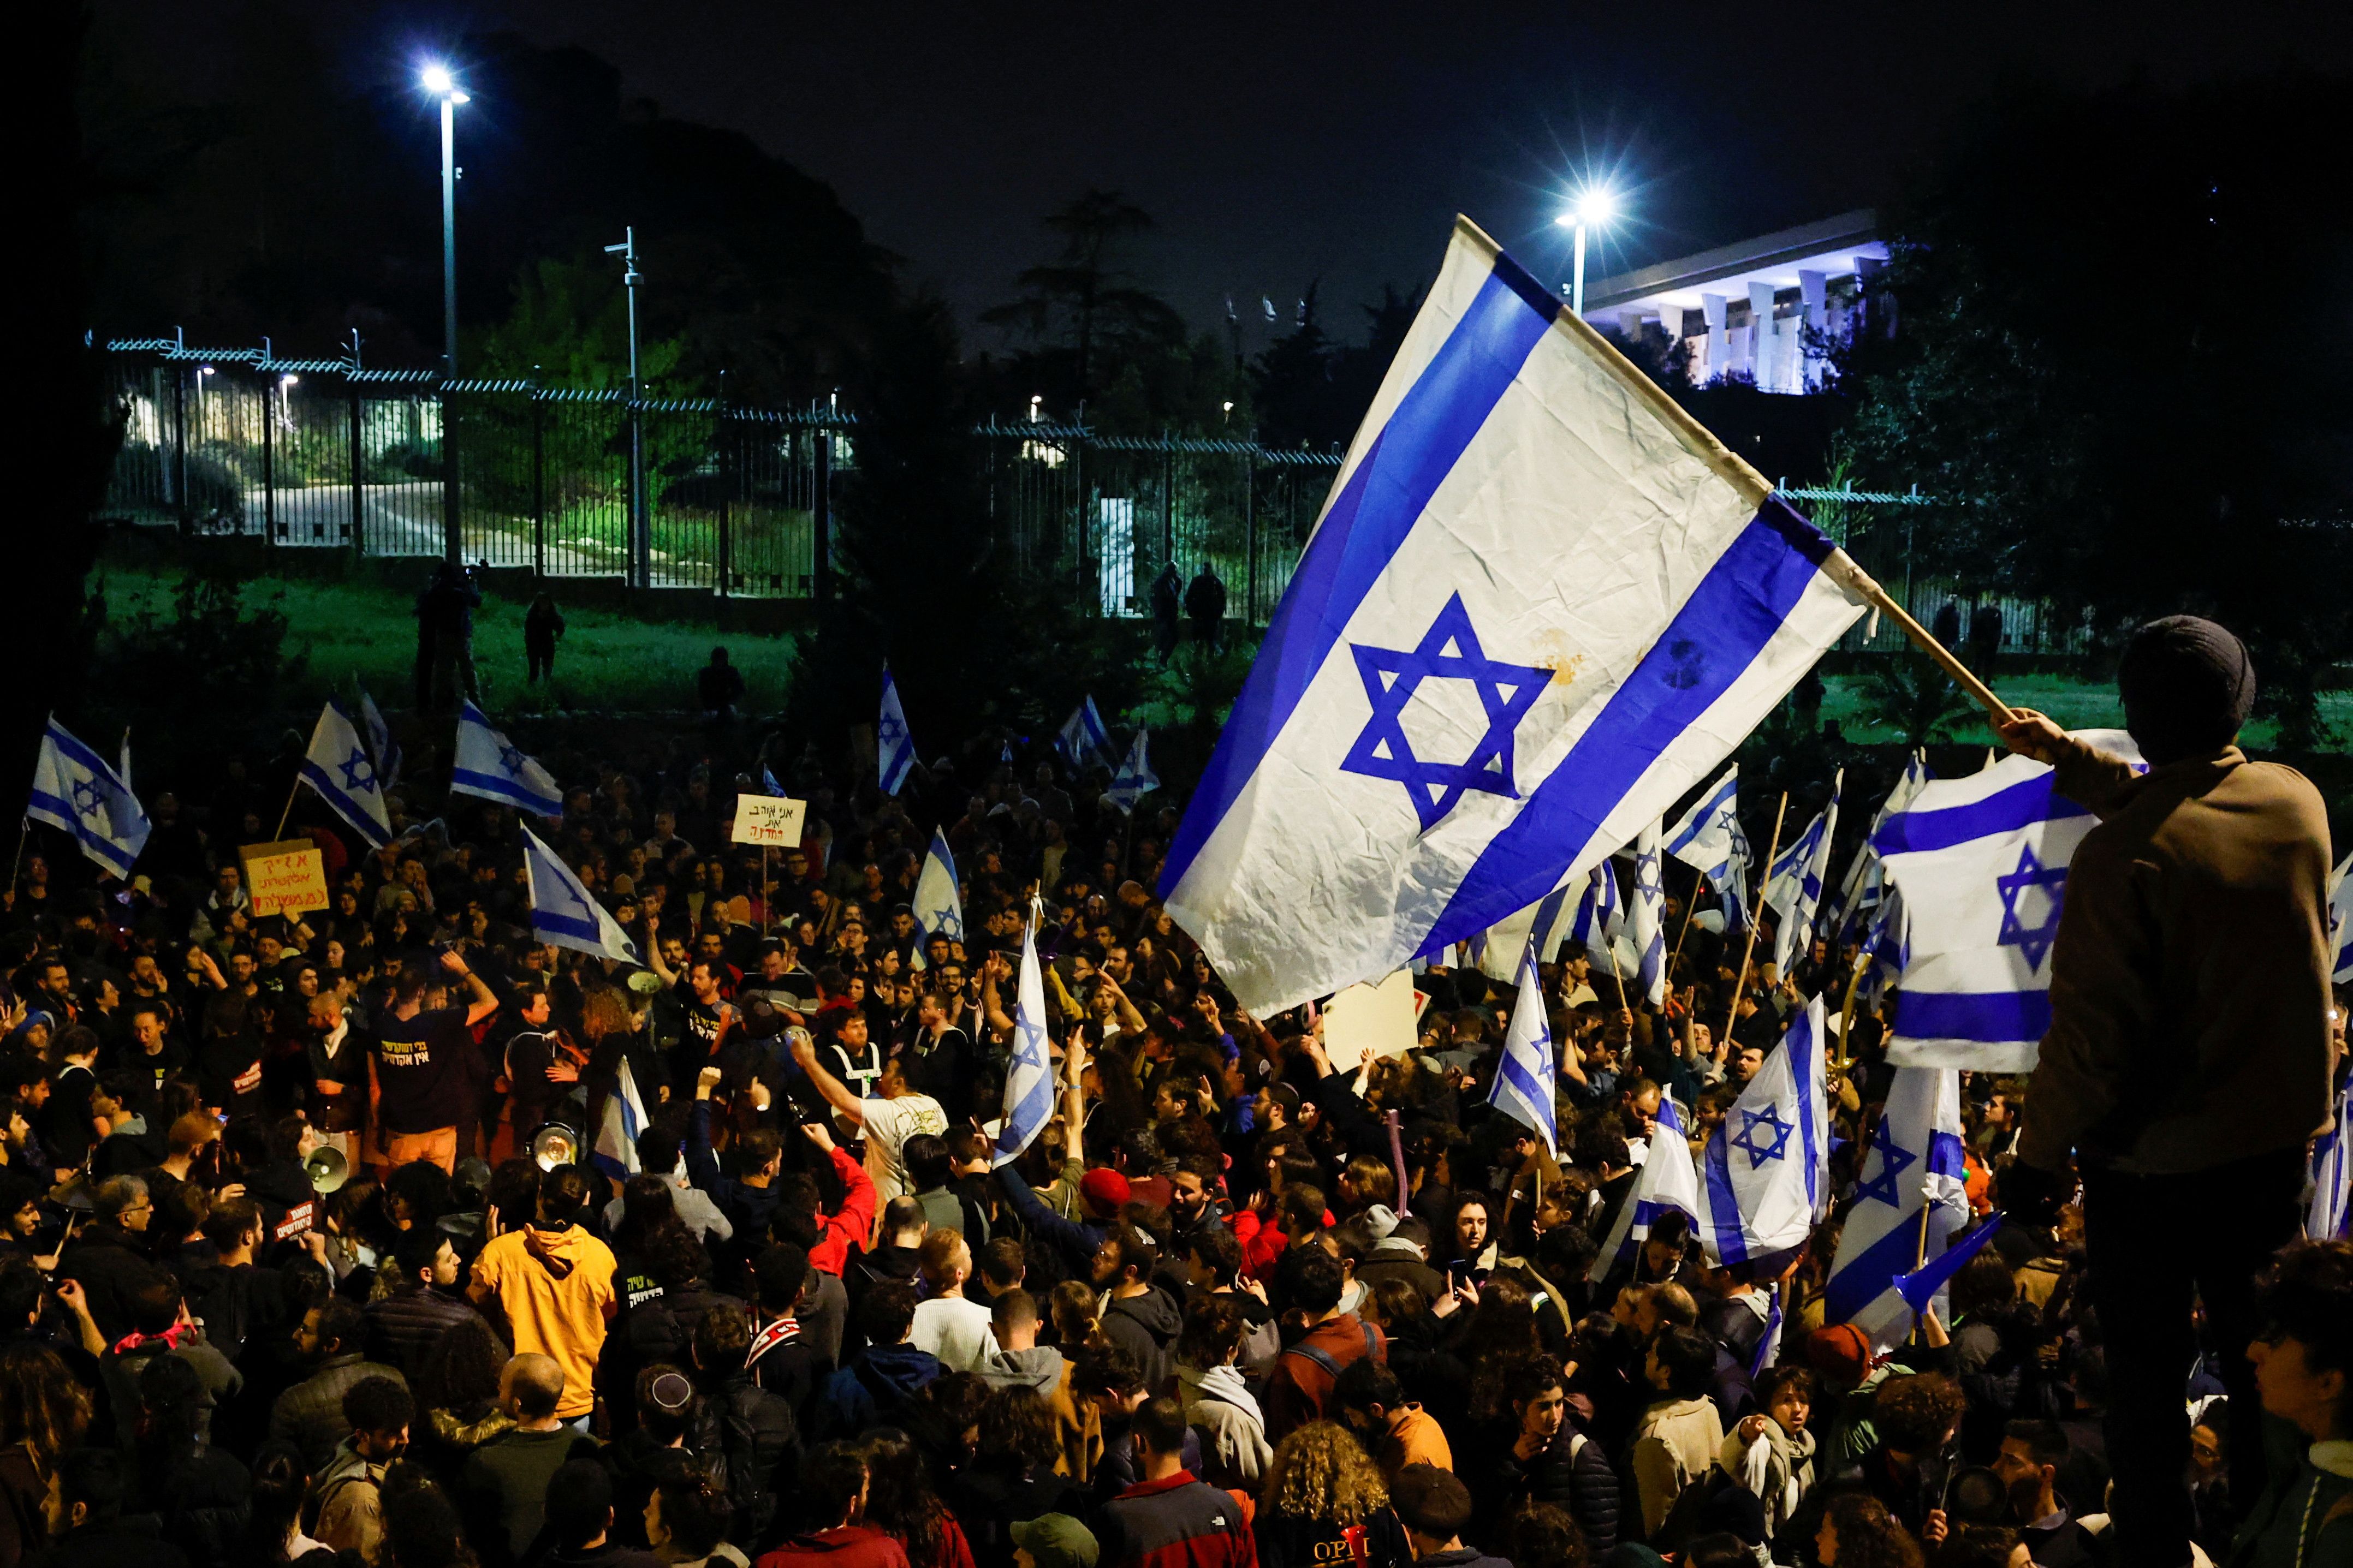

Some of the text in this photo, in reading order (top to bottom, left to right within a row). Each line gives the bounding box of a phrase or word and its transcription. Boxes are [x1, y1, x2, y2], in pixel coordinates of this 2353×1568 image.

[748, 805, 793, 819] אני אוהב
[764, 819, 781, 828] את
[750, 826, 783, 841] המדינה
[413, 1051, 430, 1066] אין
